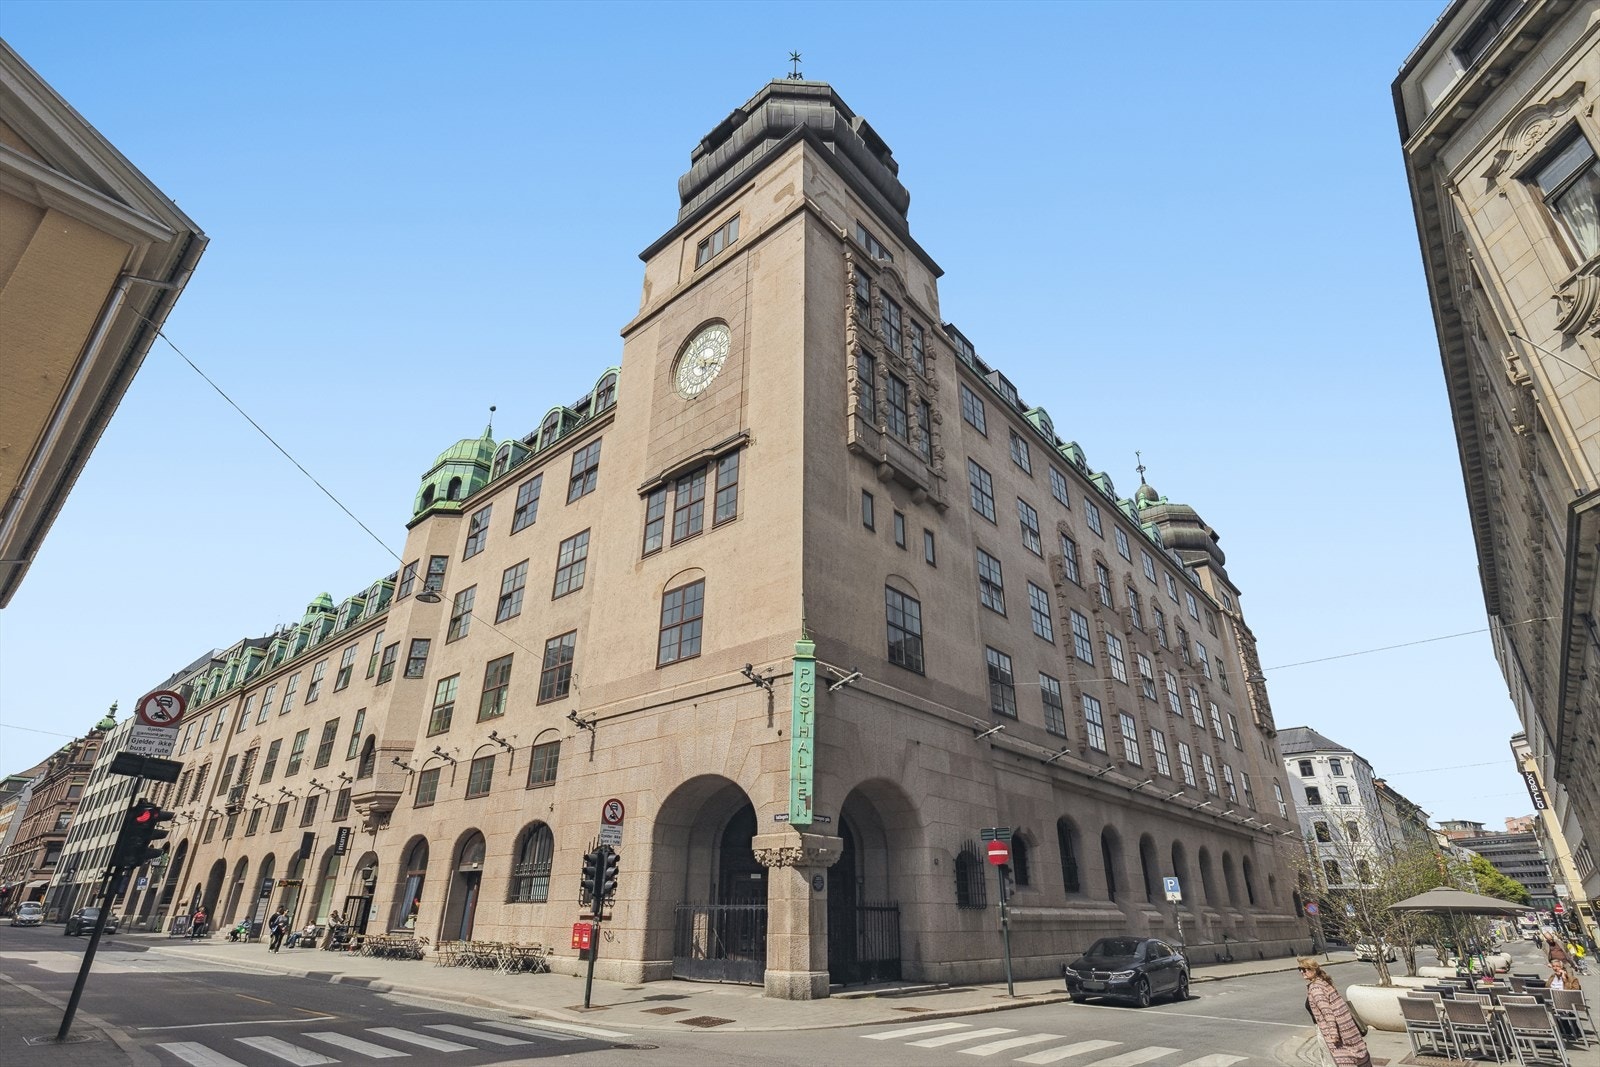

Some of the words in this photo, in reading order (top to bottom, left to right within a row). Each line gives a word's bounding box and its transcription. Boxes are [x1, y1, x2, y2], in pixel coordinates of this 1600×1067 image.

[131, 737, 155, 745] Gjelder
[796, 668, 810, 817] POSTHALLEN
[1526, 772, 1545, 809] CITYBOX
[1167, 879, 1175, 890] P
